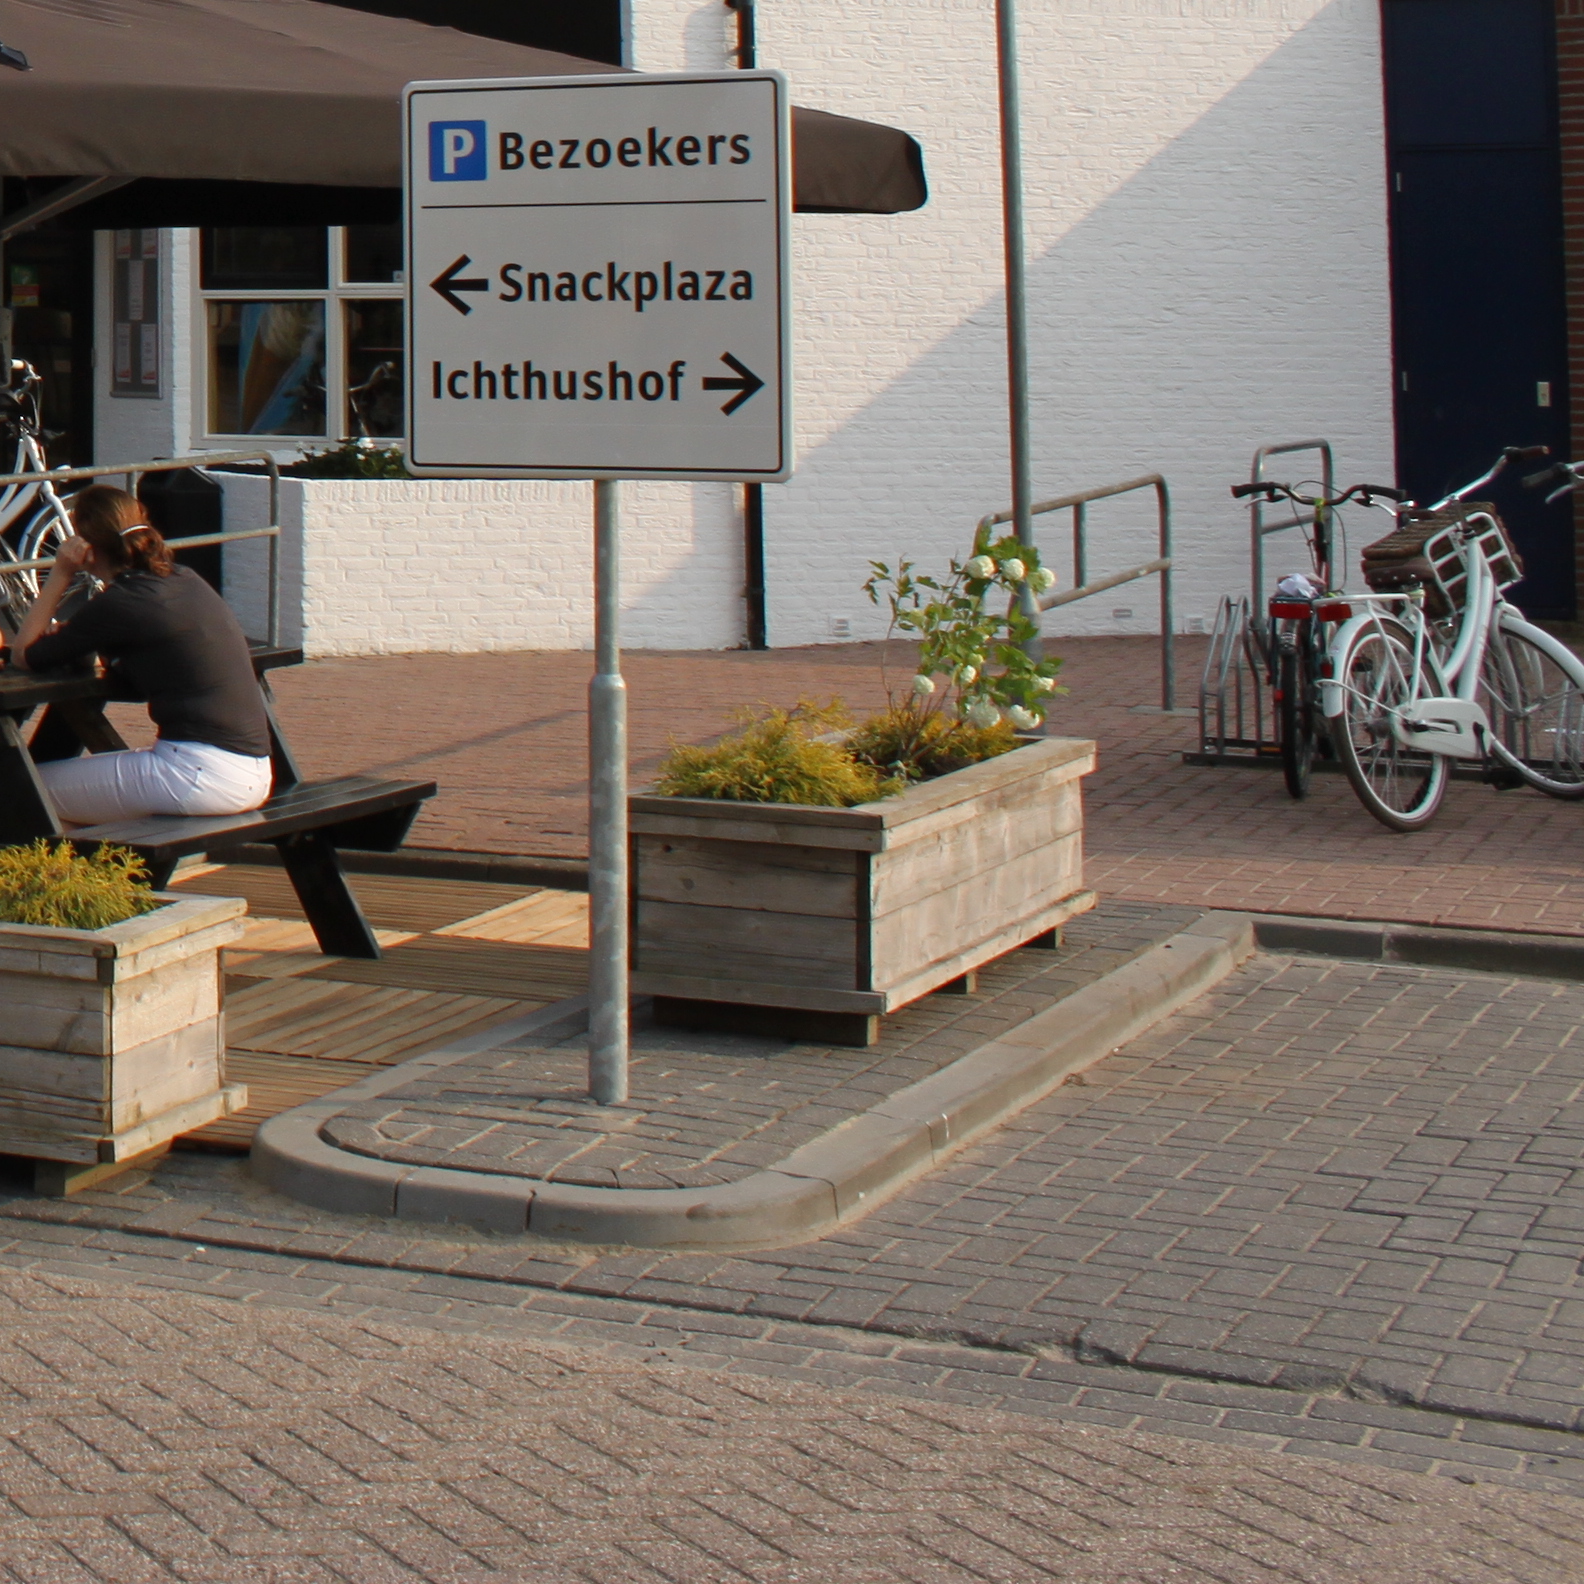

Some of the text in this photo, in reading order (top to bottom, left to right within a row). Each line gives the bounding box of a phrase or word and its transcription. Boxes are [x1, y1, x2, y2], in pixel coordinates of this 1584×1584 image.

[442, 126, 751, 174] P Bezoekers
[498, 261, 753, 312] Snackplaza
[432, 359, 686, 401] Ichthushof
